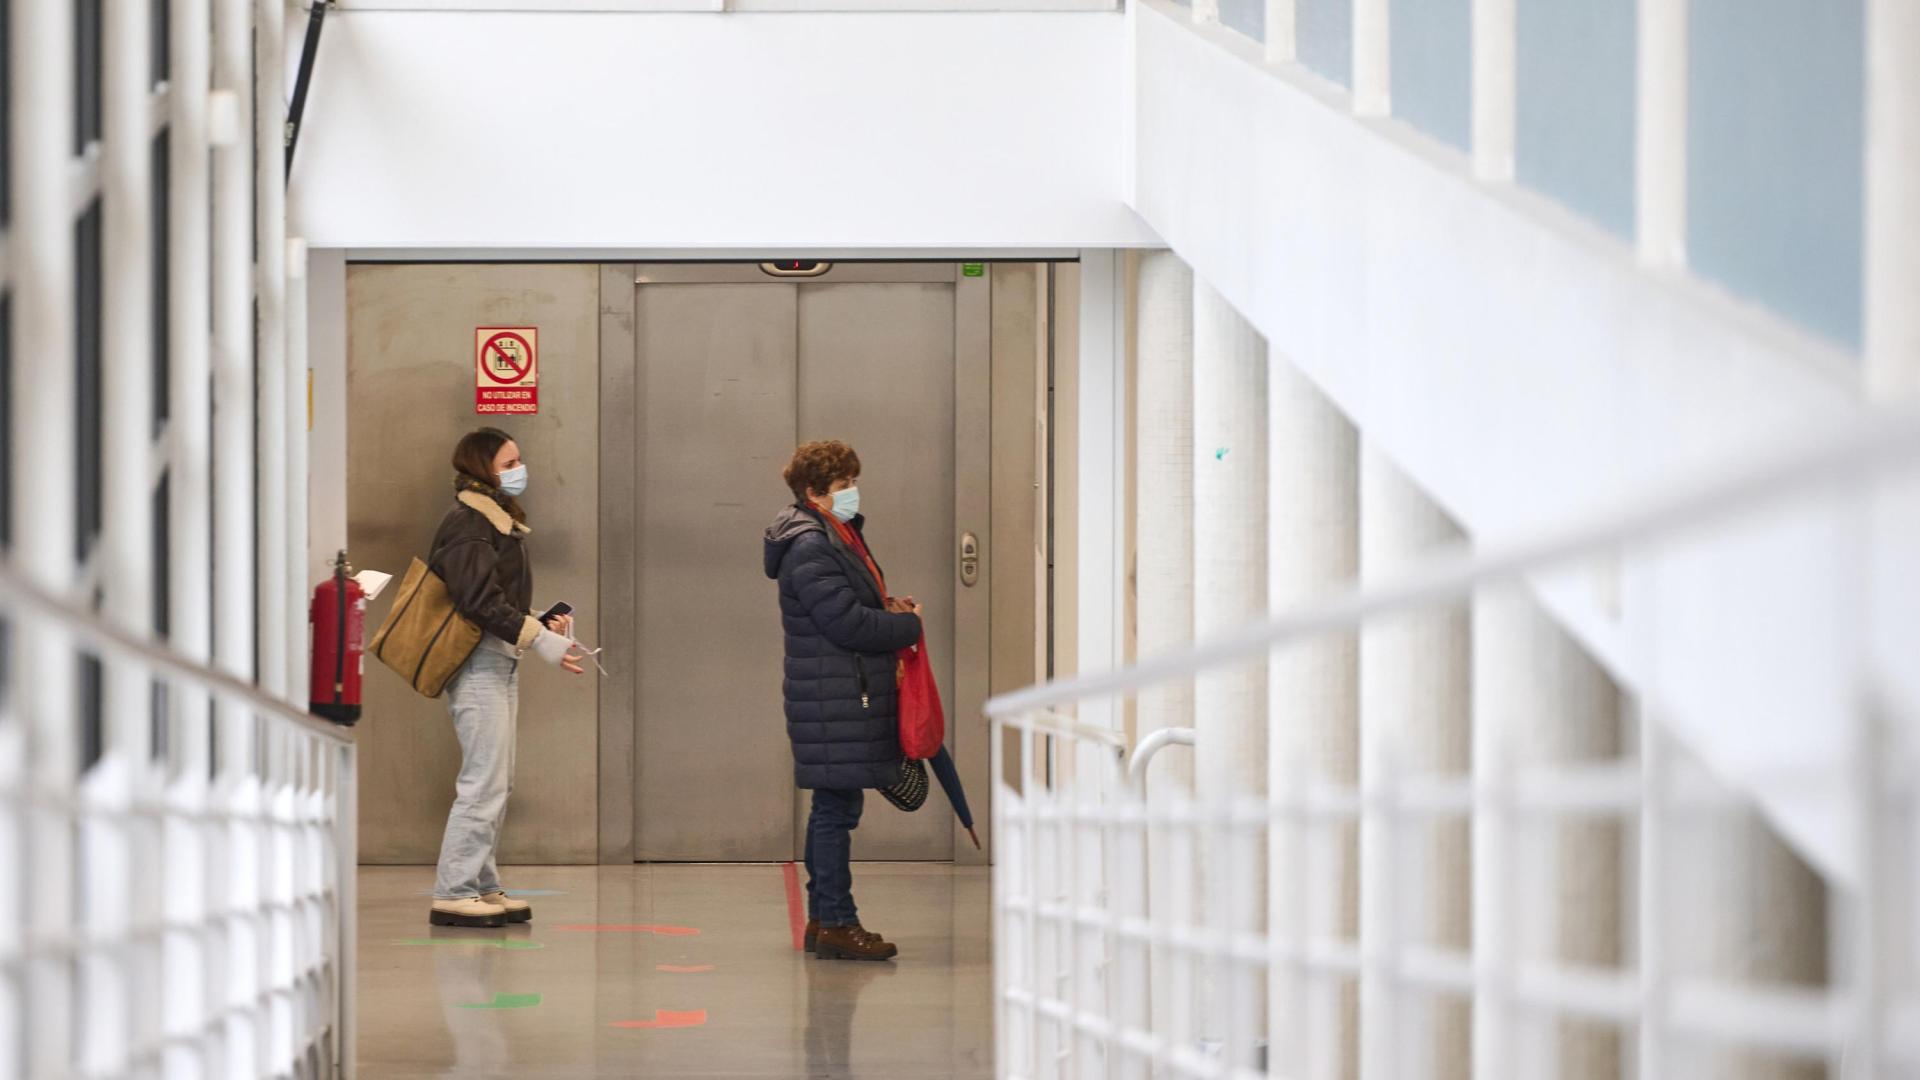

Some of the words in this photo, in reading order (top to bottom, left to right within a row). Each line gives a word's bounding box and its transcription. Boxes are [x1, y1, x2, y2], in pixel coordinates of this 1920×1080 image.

[482, 391, 492, 399] NO
[493, 391, 520, 399] UTILIZAR
[521, 391, 531, 399] EN
[477, 403, 495, 411] CASO
[496, 403, 505, 411] DE
[506, 403, 536, 411] INCENDIO
